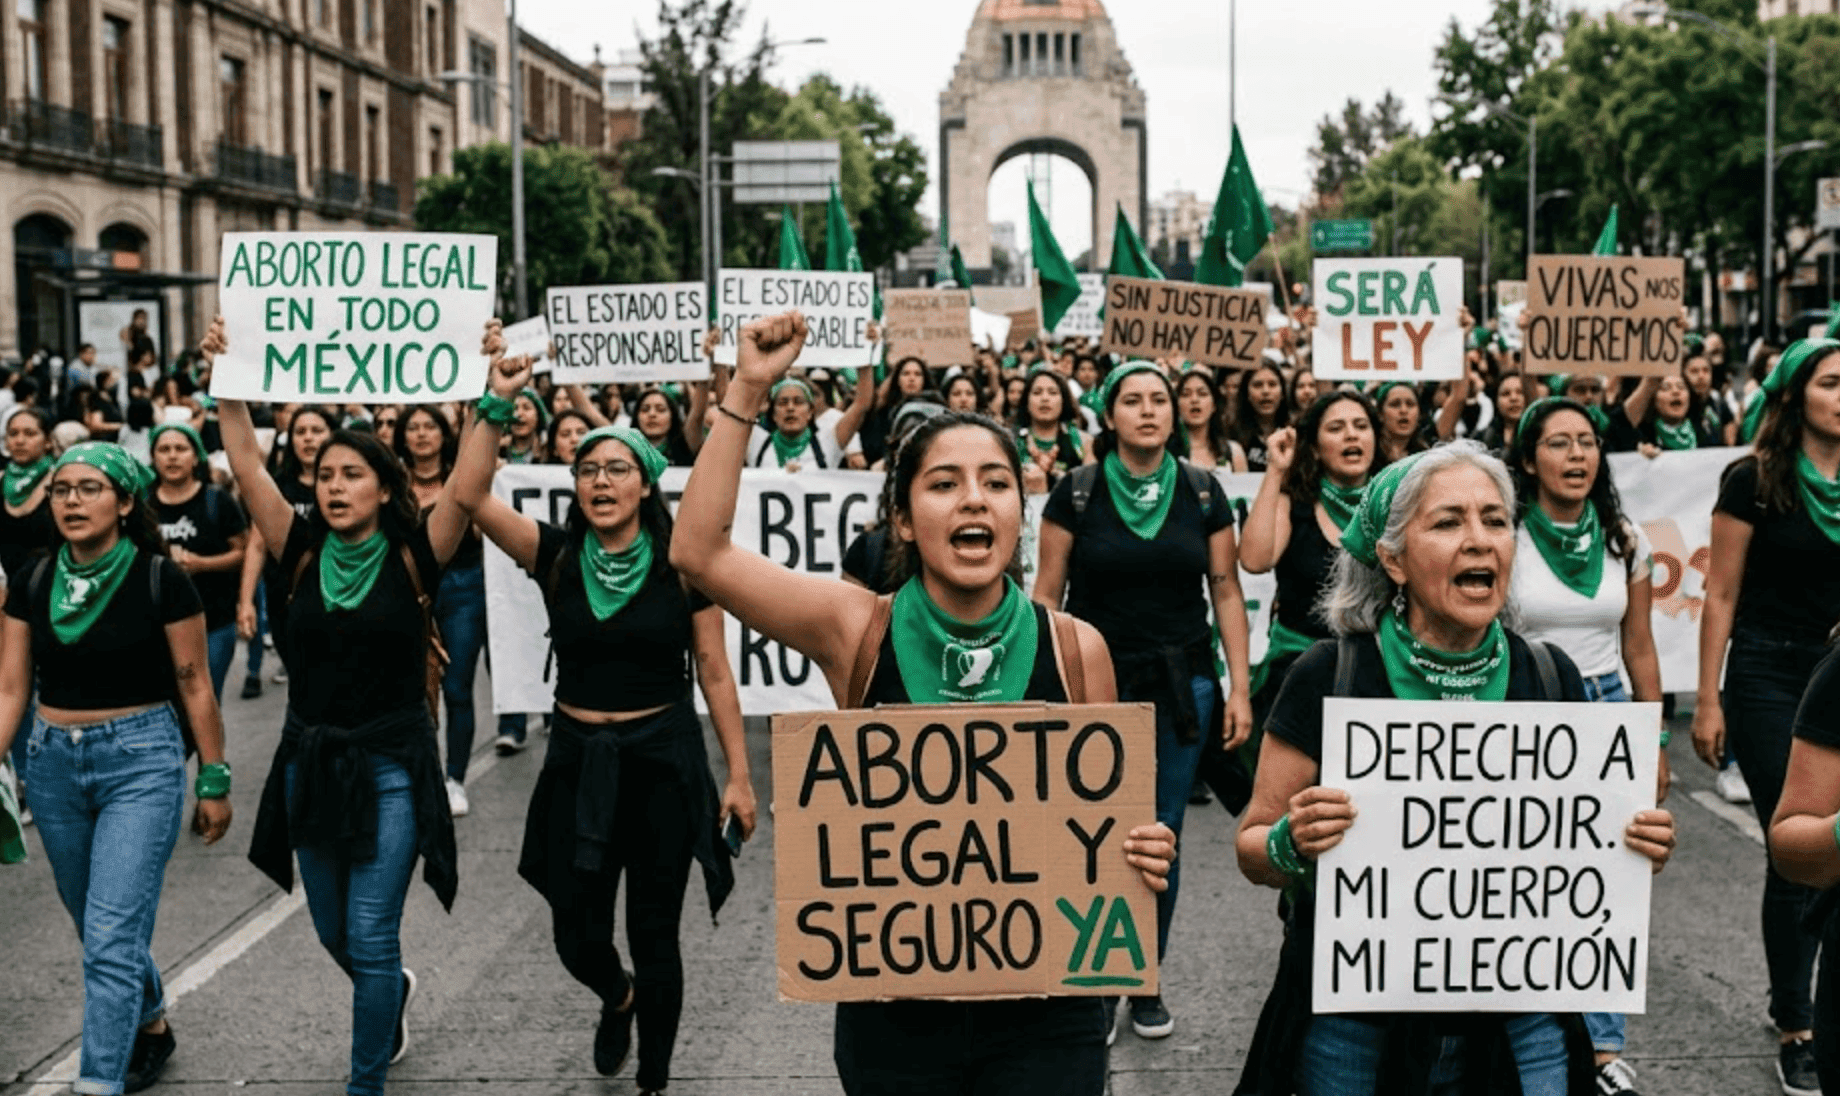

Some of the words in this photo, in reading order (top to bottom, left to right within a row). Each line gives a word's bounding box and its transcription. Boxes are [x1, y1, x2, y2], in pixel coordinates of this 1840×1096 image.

[227, 240, 366, 288] ABORTO
[381, 242, 488, 291] LEGAL
[1325, 261, 1441, 316] SERÁ
[1538, 266, 1640, 310] VIVAS
[1645, 277, 1681, 300] NOS
[265, 297, 314, 332] EN
[338, 296, 440, 332] TODO
[552, 294, 577, 324] EL
[587, 291, 666, 323] ESTADO
[675, 290, 701, 319] ES
[723, 277, 751, 305] EL
[761, 277, 840, 307] ESTADO
[847, 281, 869, 308] ES
[1110, 282, 1150, 311] SIN
[1156, 289, 1264, 323] JUSTICIA
[263, 329, 460, 395] MÉXICO
[554, 327, 704, 368] RESPONSABLE
[1110, 319, 1145, 348] NO
[1151, 320, 1198, 355] HAY
[1204, 329, 1258, 361] PAZ
[1341, 321, 1434, 371] LEY
[1529, 315, 1682, 364] QUEREMOS
[798, 720, 1125, 809] ABORTO
[1345, 721, 1578, 782] DERECHO
[1599, 724, 1635, 781] A
[1402, 795, 1617, 851] DECIDIR.
[817, 818, 1040, 888] LEGAL
[1065, 816, 1116, 885] Y
[1334, 866, 1388, 919] MI
[1414, 866, 1612, 924] CUERPO,
[797, 898, 1043, 981] SEGURO
[1055, 895, 1147, 973] YA
[1332, 937, 1387, 994] MI
[1413, 926, 1637, 993] ELECCIÓN
